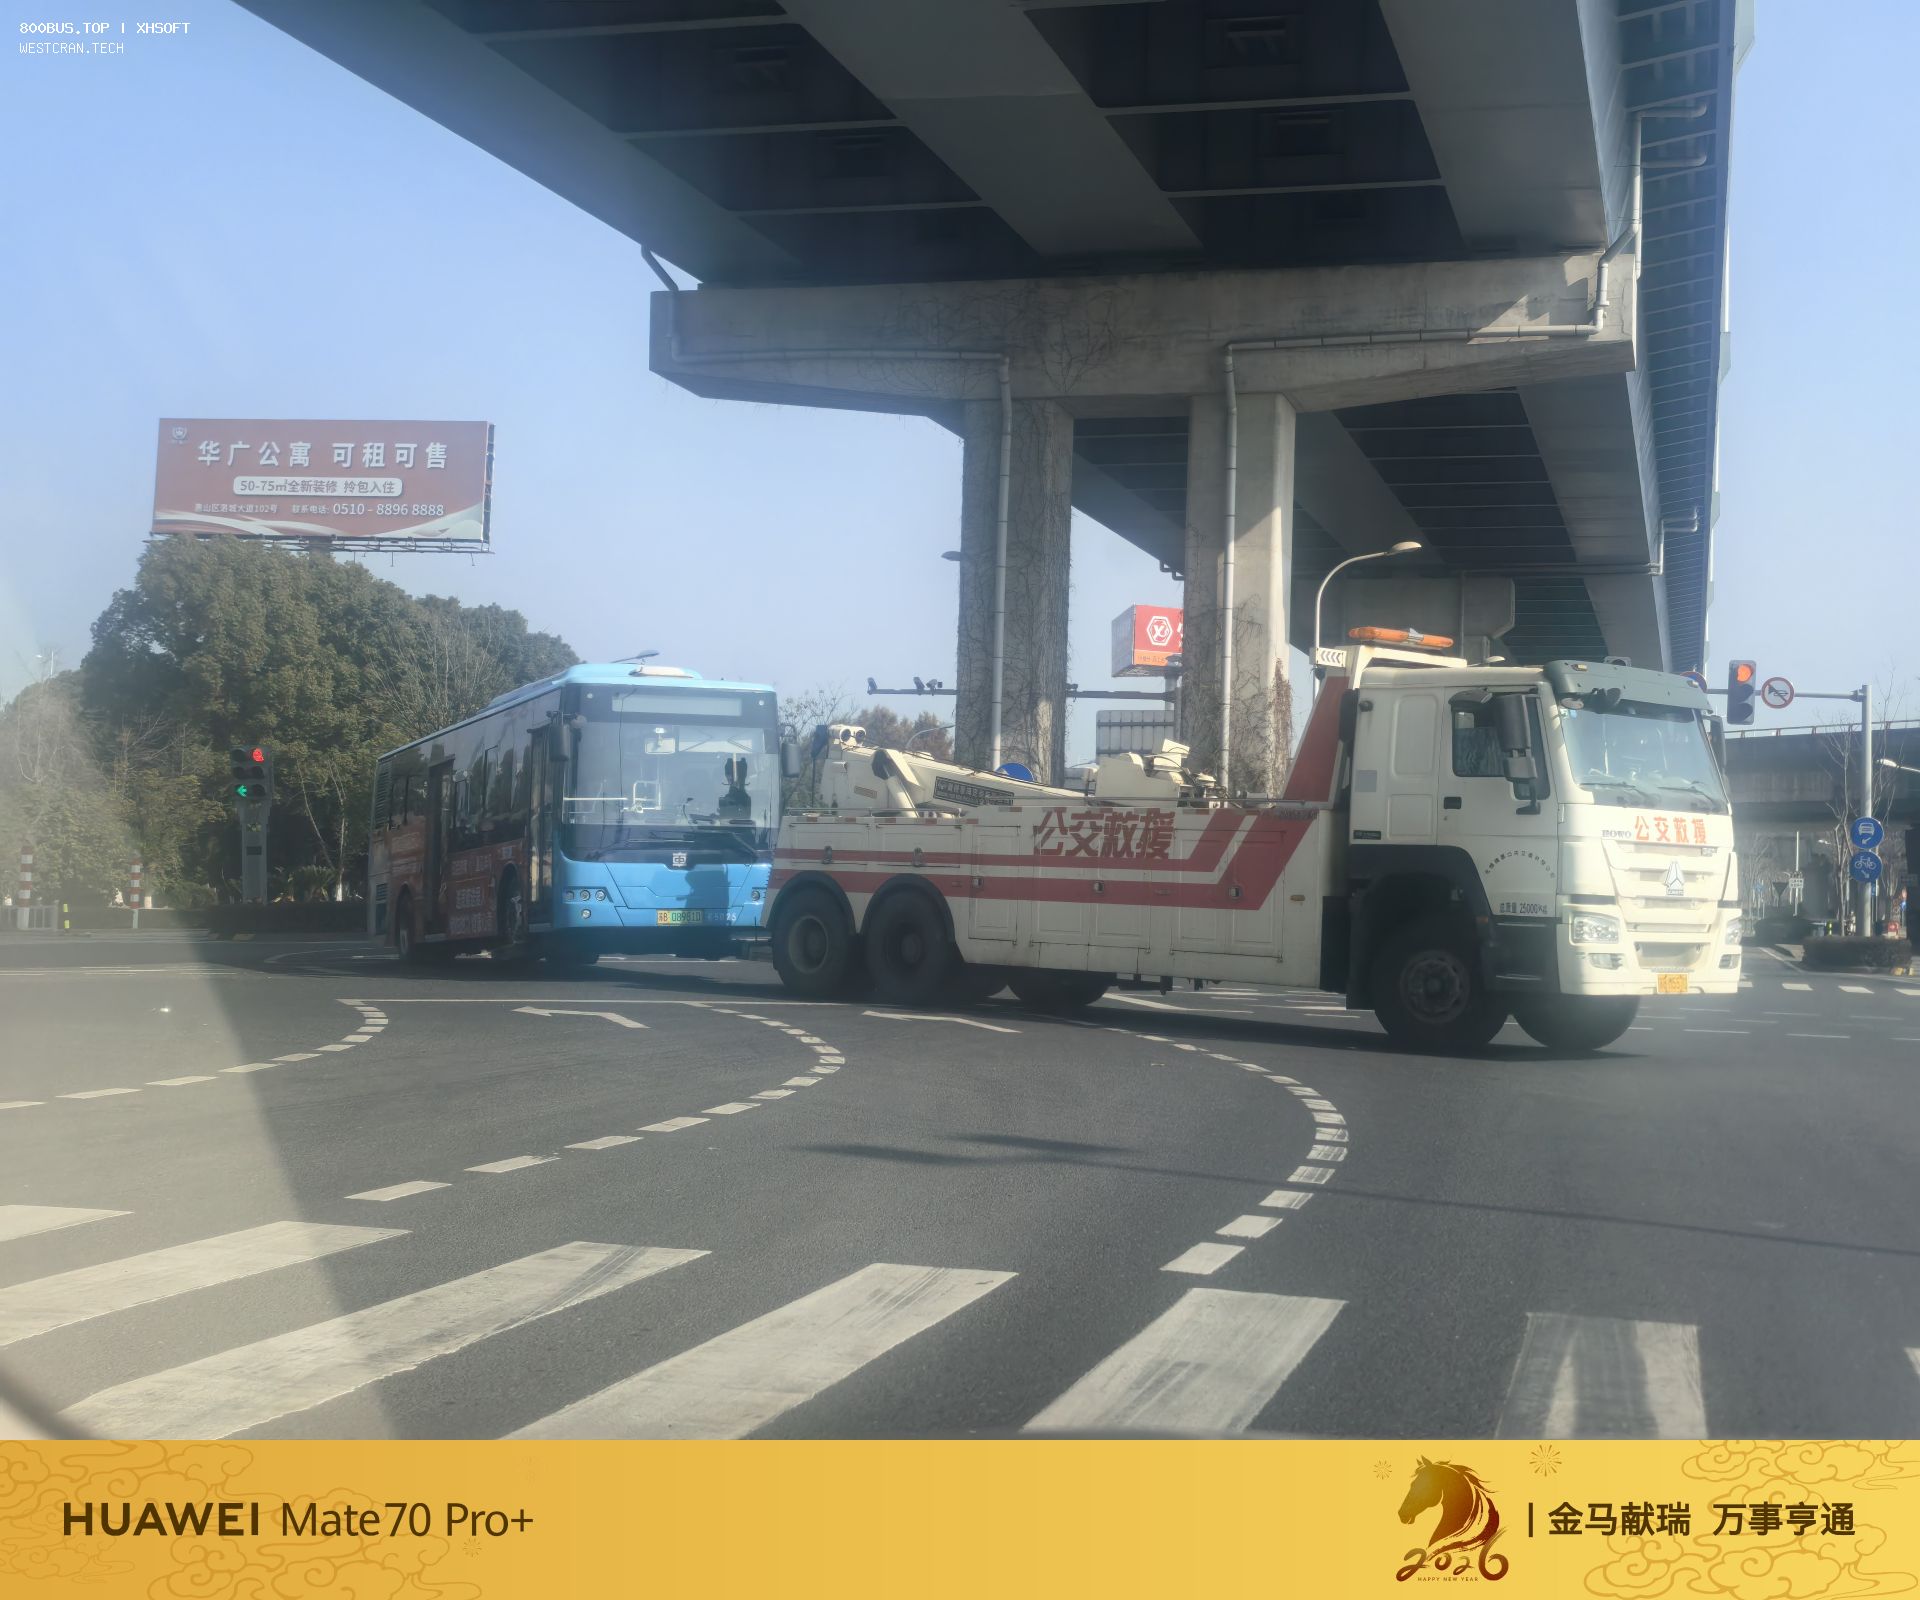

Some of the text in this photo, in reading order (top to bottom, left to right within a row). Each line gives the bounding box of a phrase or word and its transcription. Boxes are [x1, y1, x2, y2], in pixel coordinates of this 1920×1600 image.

[198, 440, 447, 469] 华广公寓 可租可售
[344, 481, 395, 494] 拎包入住
[333, 503, 365, 515] 0510
[376, 503, 408, 516] 8896
[412, 504, 444, 516] 8888
[1034, 807, 1175, 859] 公交救援
[1634, 815, 1707, 844] 公交救援
